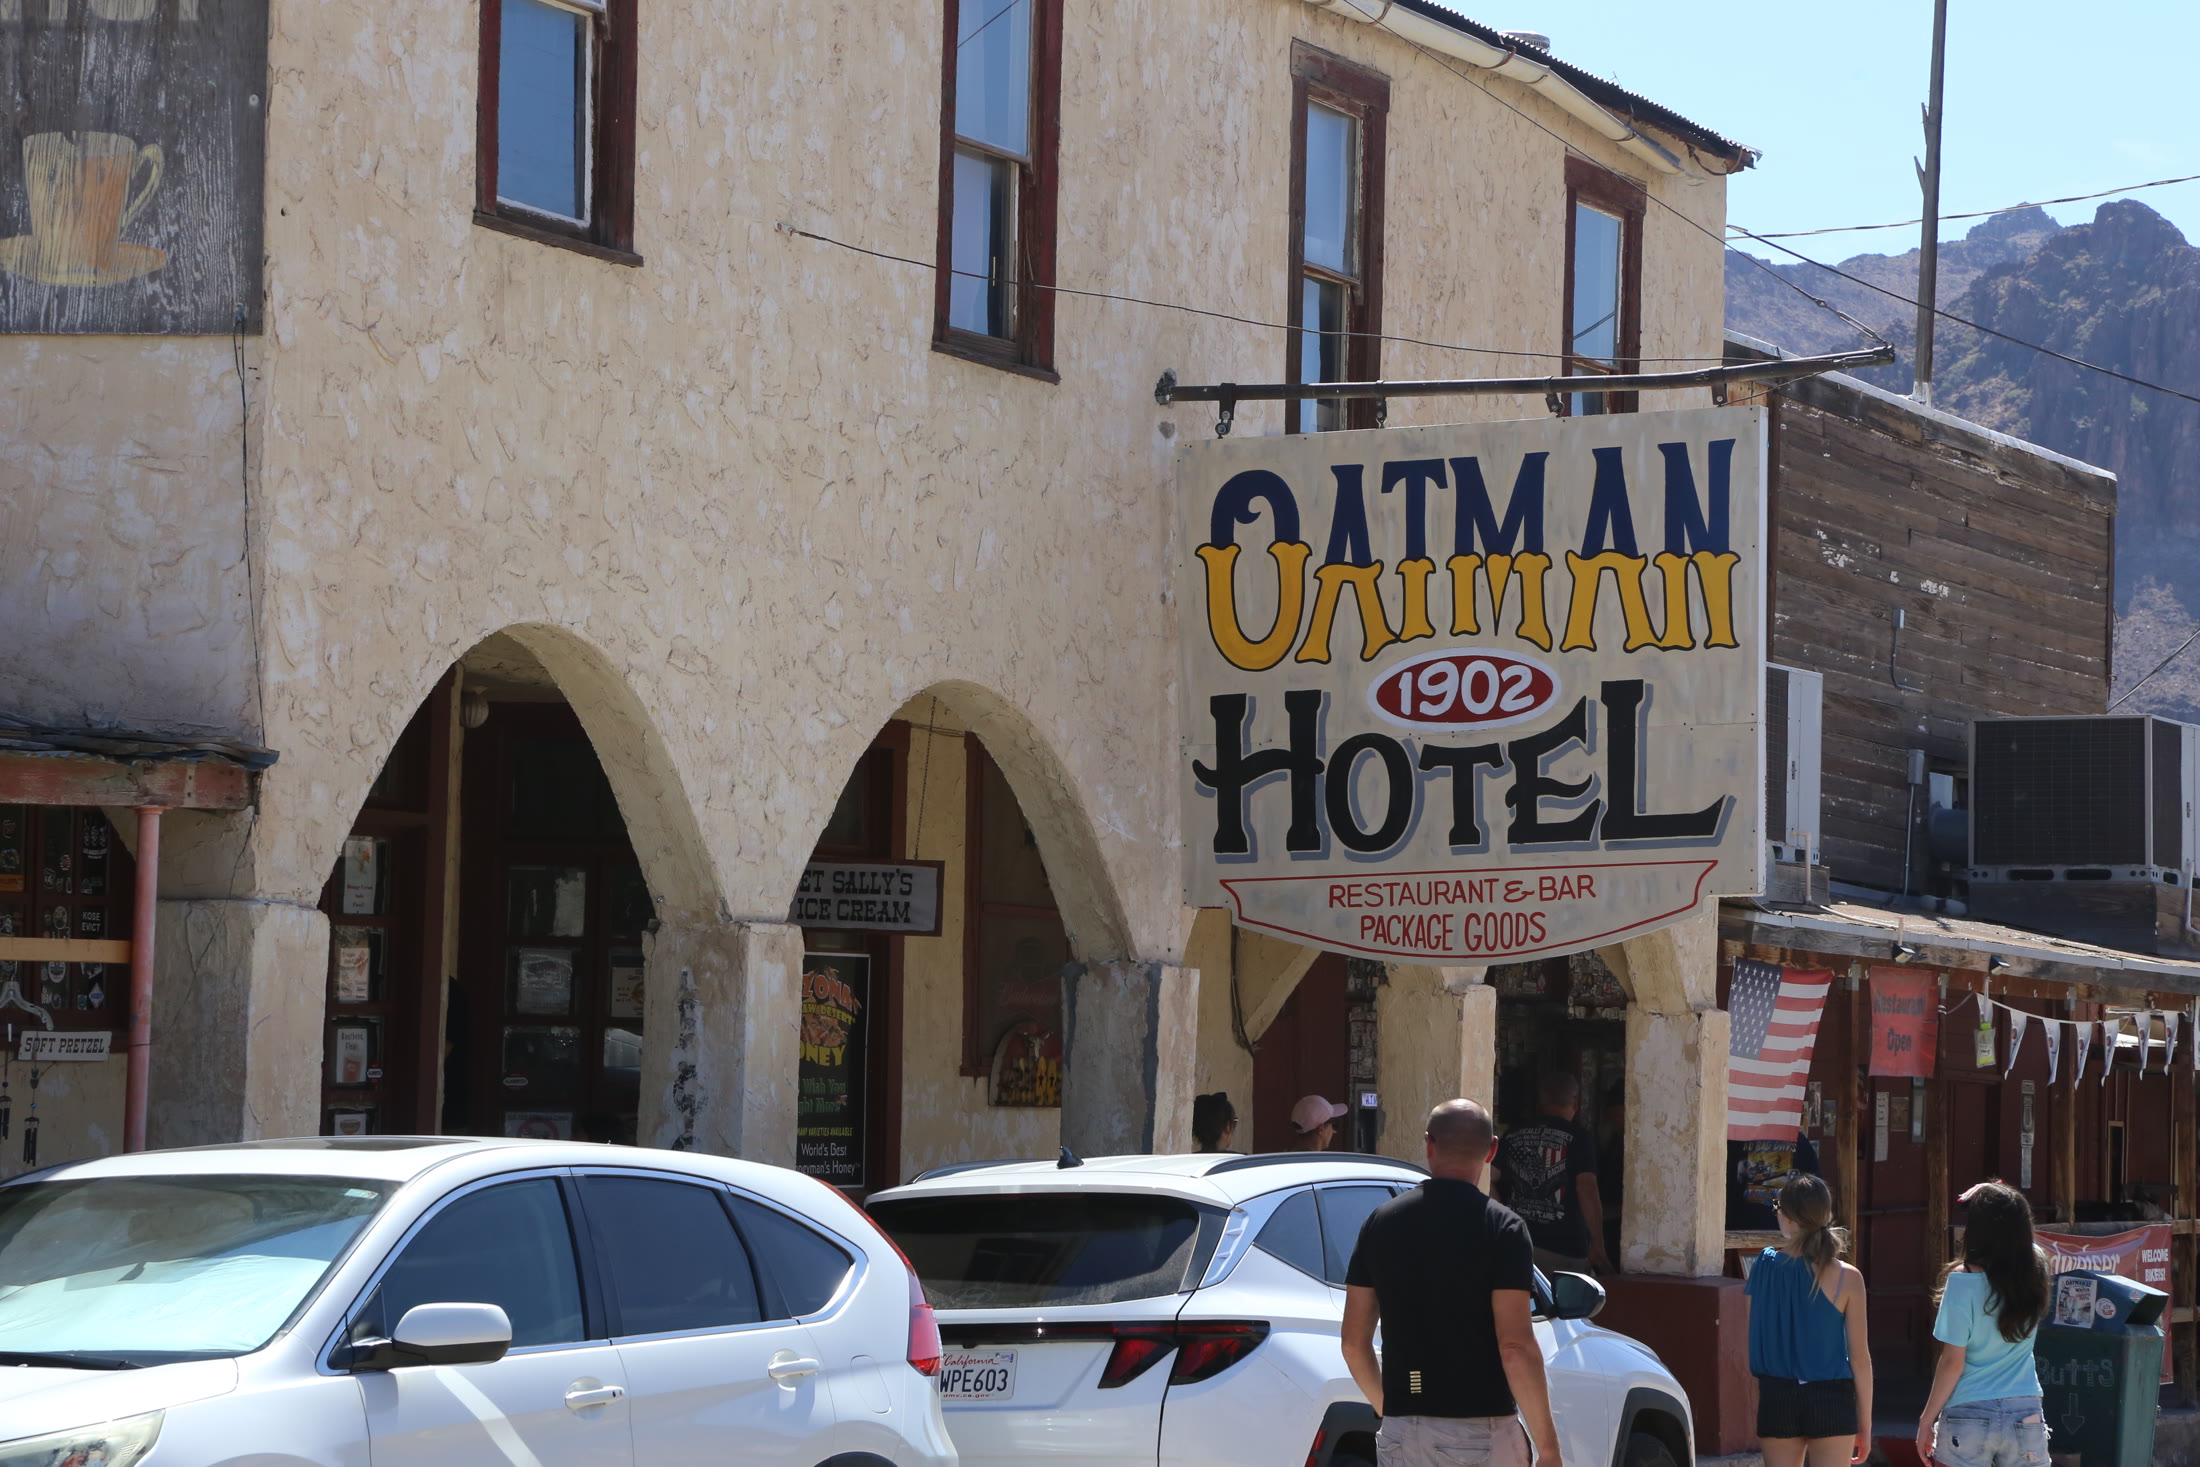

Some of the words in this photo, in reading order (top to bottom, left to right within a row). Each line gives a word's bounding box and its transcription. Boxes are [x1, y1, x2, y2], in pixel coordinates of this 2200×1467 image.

[1195, 438, 1741, 672] OATMAN
[1398, 659, 1535, 717] 1902
[1192, 679, 1737, 862] HOTEL
[833, 869, 913, 896] SALLY'S
[1328, 879, 1495, 909] RESTAURANT
[1539, 874, 1597, 901] BAR
[797, 898, 831, 920] ICE
[837, 899, 911, 924] CREAM
[1360, 912, 1454, 951] PACKAGE
[1464, 911, 1547, 952] GOODS
[25, 1037, 56, 1053] SOFT
[58, 1038, 105, 1054] PRETZEL
[1887, 1028, 1912, 1057] Open
[801, 1142, 829, 1157] World's
[830, 1142, 848, 1157] Best
[2141, 1248, 2169, 1264] WELCOME
[943, 1354, 1000, 1369] California
[940, 1368, 1009, 1393] WPE603
